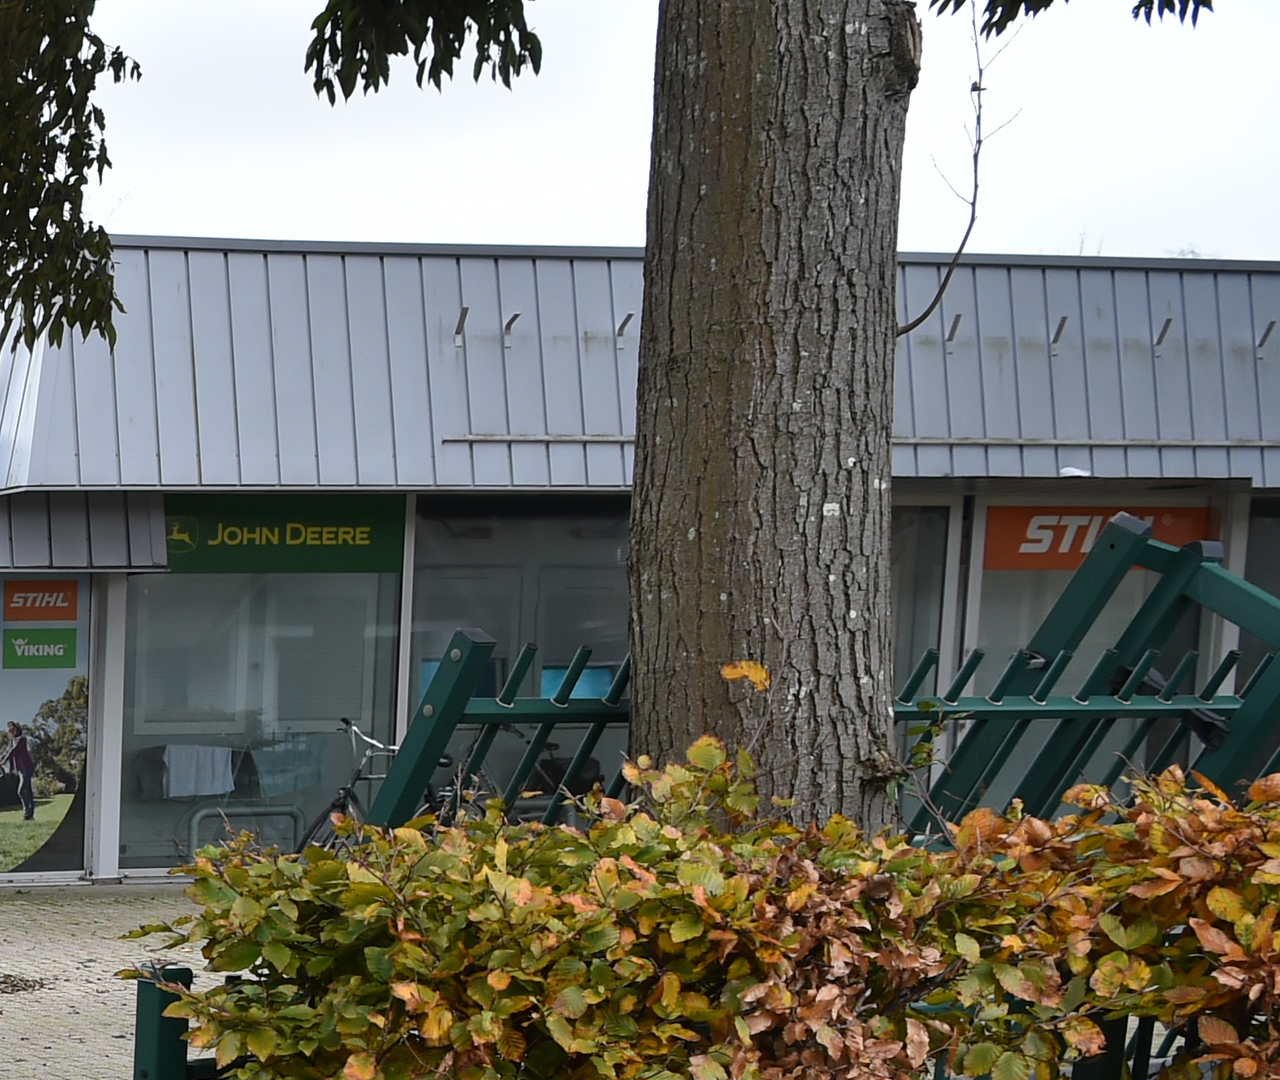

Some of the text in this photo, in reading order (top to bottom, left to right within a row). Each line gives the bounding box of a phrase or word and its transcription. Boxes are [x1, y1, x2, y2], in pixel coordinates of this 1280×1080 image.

[207, 522, 371, 546] JOHN DEERE
[1019, 515, 1155, 553] STI
[10, 592, 69, 608] STIHL
[14, 644, 65, 657] VIKING
